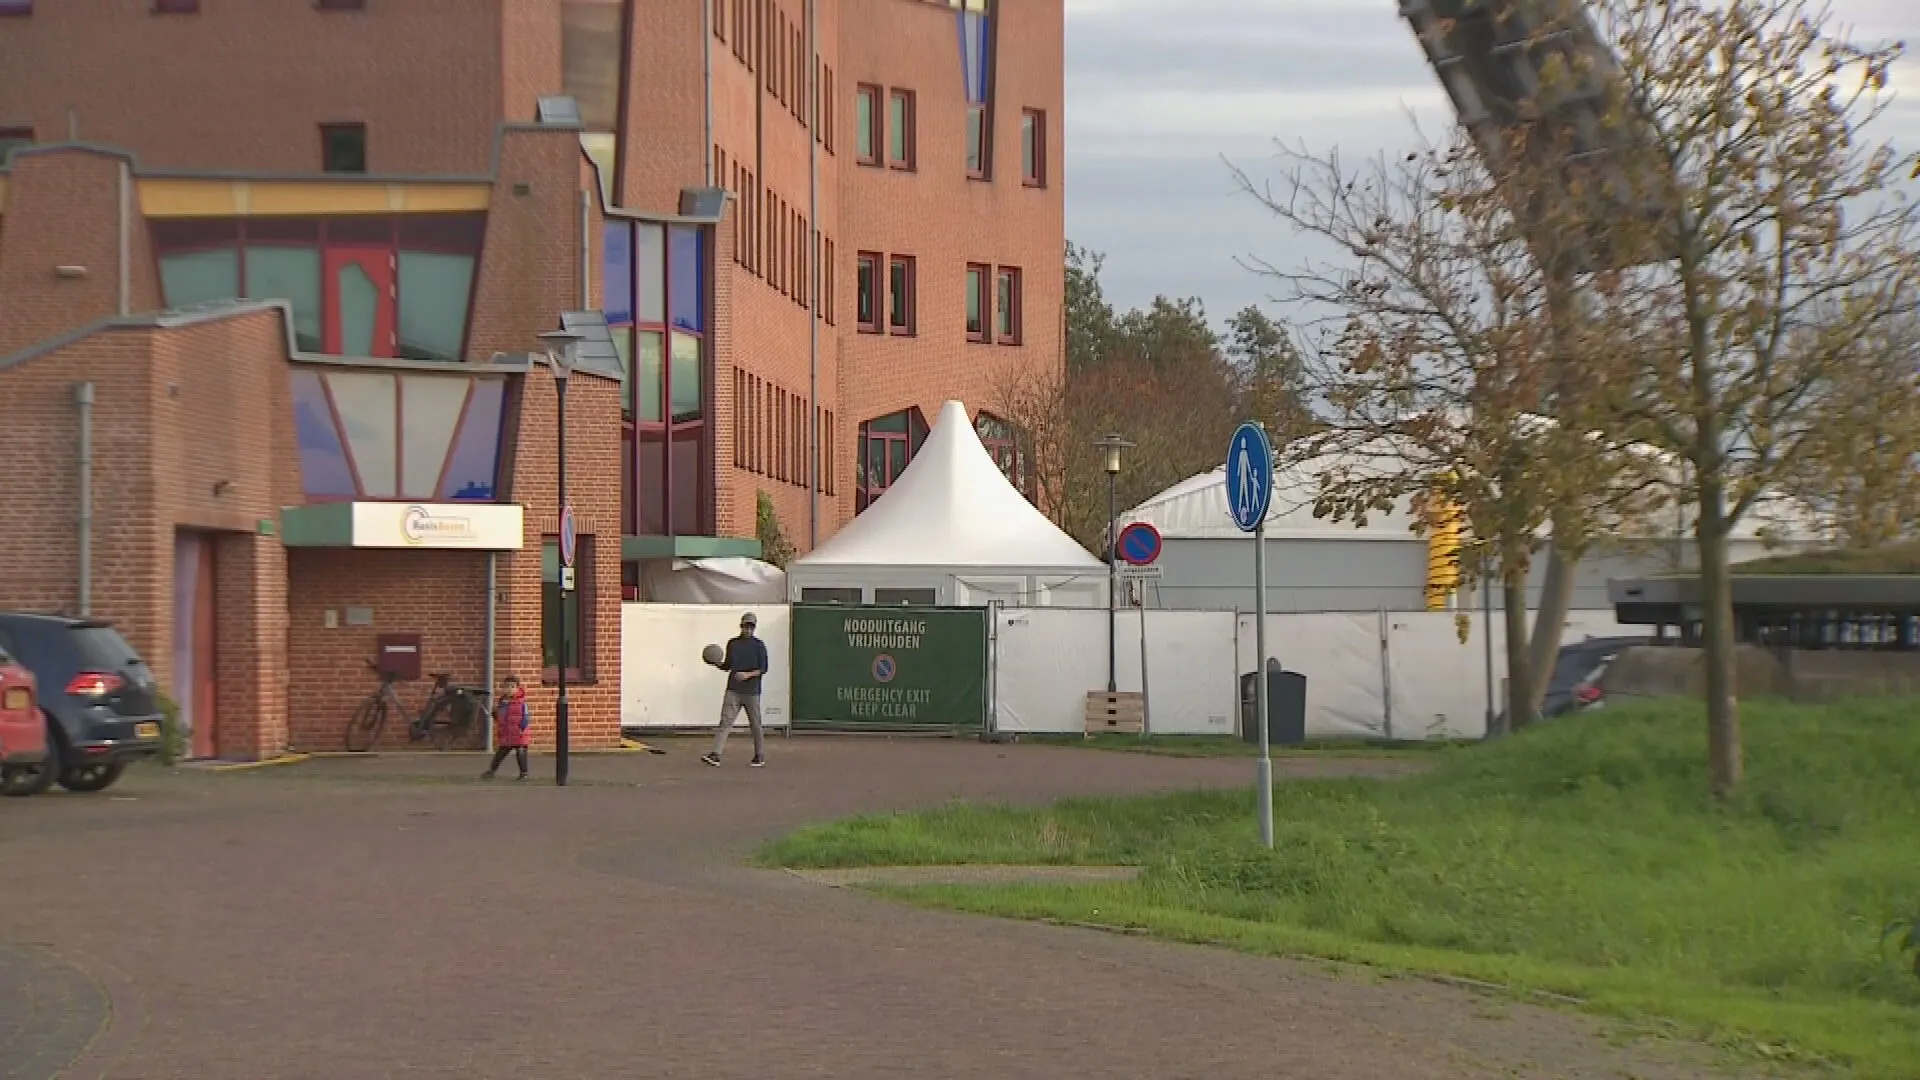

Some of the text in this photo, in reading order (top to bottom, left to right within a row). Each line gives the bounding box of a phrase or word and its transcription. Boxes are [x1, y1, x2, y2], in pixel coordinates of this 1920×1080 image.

[844, 618, 926, 634] NOODUITGANG
[848, 633, 920, 649] VRIJHOUDEN
[837, 687, 931, 703] EMERGENCY EXIT
[851, 702, 917, 717] KEEP CLEAR
